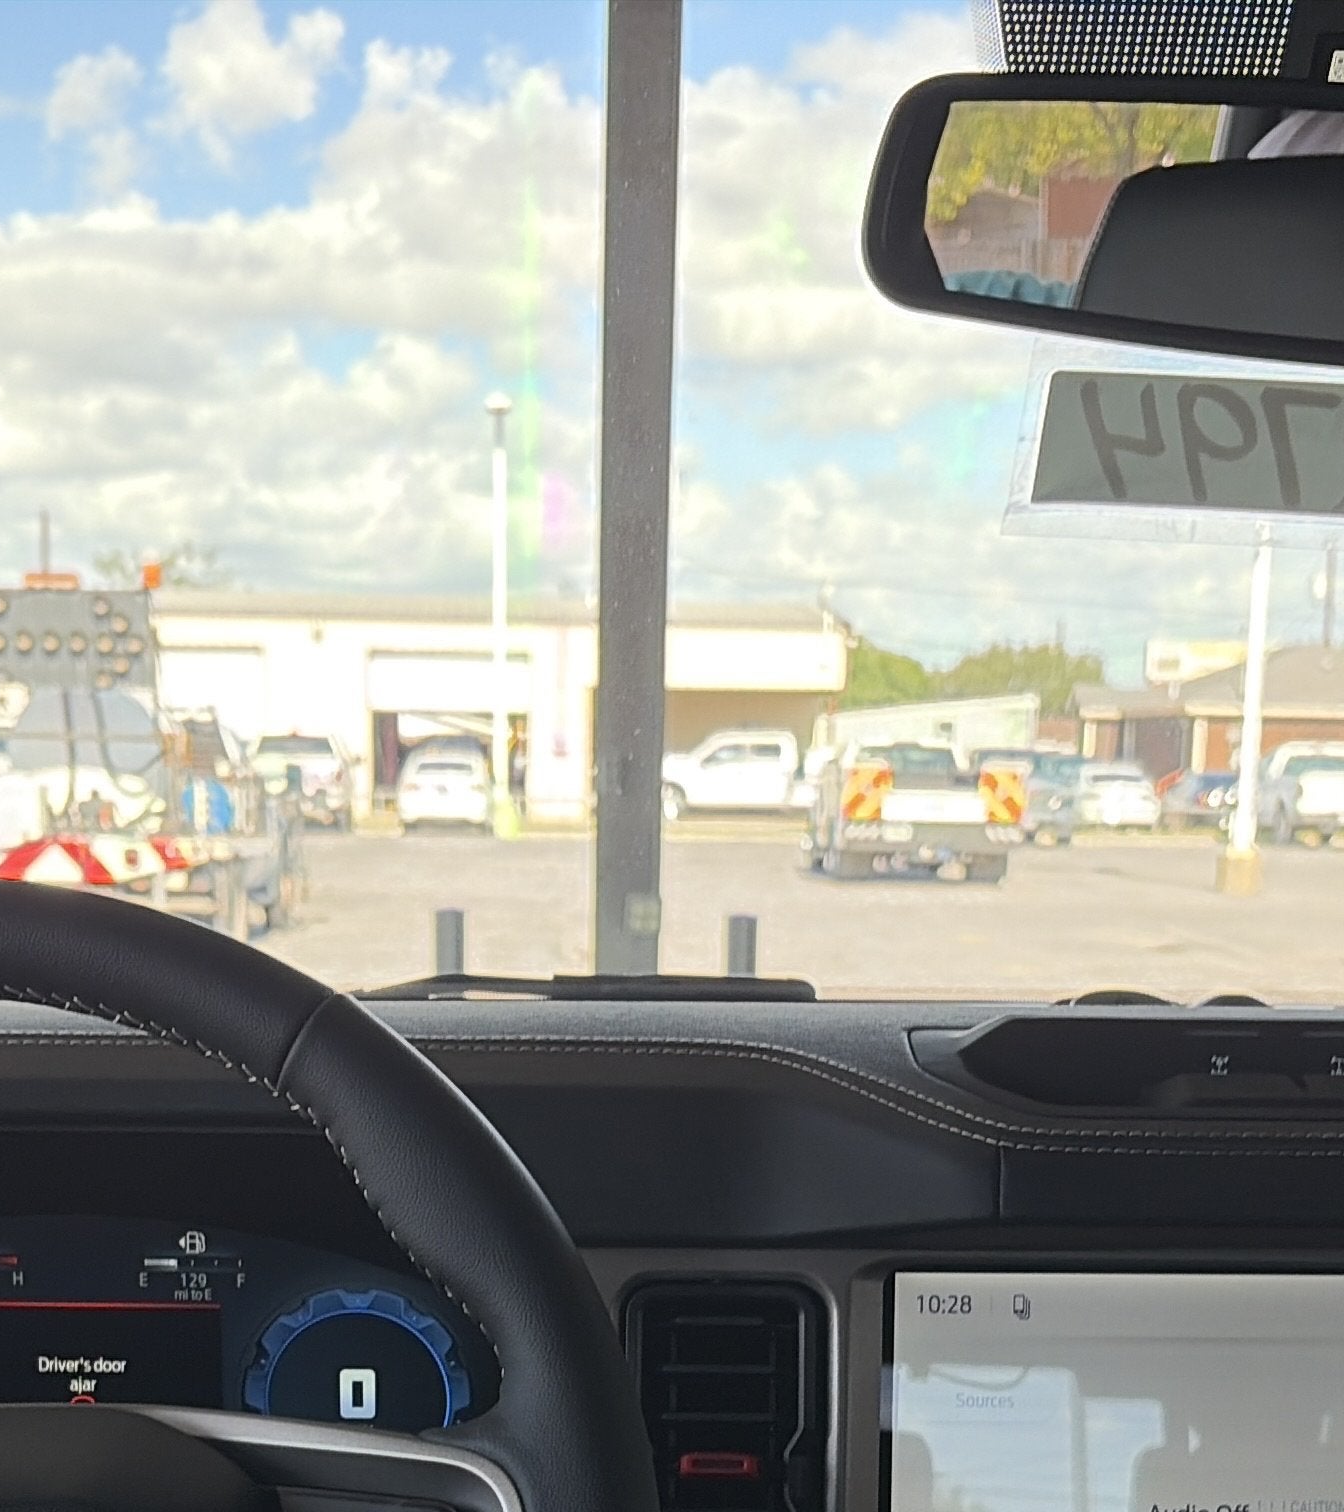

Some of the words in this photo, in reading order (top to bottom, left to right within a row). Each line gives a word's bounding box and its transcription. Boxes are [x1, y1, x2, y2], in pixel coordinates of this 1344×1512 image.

[12, 1272, 24, 1285] H
[139, 1272, 149, 1287] E
[180, 1273, 207, 1288] 129
[237, 1273, 246, 1288] F
[916, 1293, 973, 1315] 10:28
[38, 1356, 92, 1373] Driver's
[93, 1356, 127, 1373] door
[69, 1375, 97, 1395] ajar
[339, 1368, 376, 1420] 0
[954, 1391, 1016, 1411] Sources
